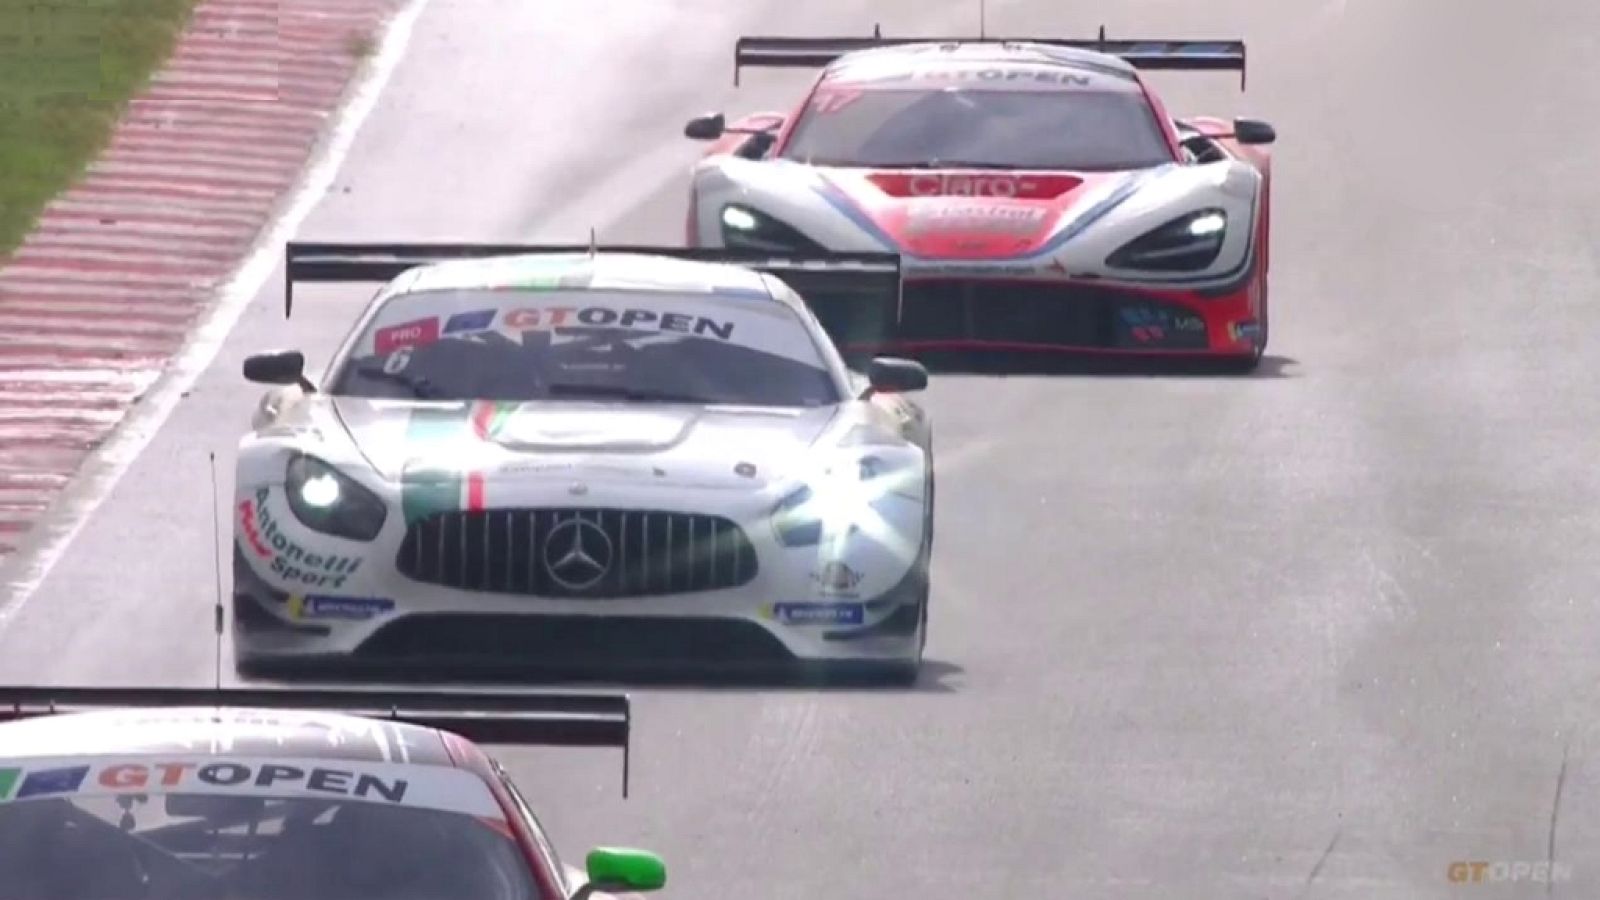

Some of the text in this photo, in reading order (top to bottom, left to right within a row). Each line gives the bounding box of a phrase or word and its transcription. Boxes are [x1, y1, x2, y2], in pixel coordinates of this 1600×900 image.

[909, 174, 1017, 198] Claro
[390, 325, 422, 343] PRO
[503, 306, 735, 340] GTOPEN
[384, 349, 413, 375] 6
[255, 485, 364, 574] Antonelli
[270, 555, 349, 589] Sport
[98, 762, 409, 803] GTOPEN
